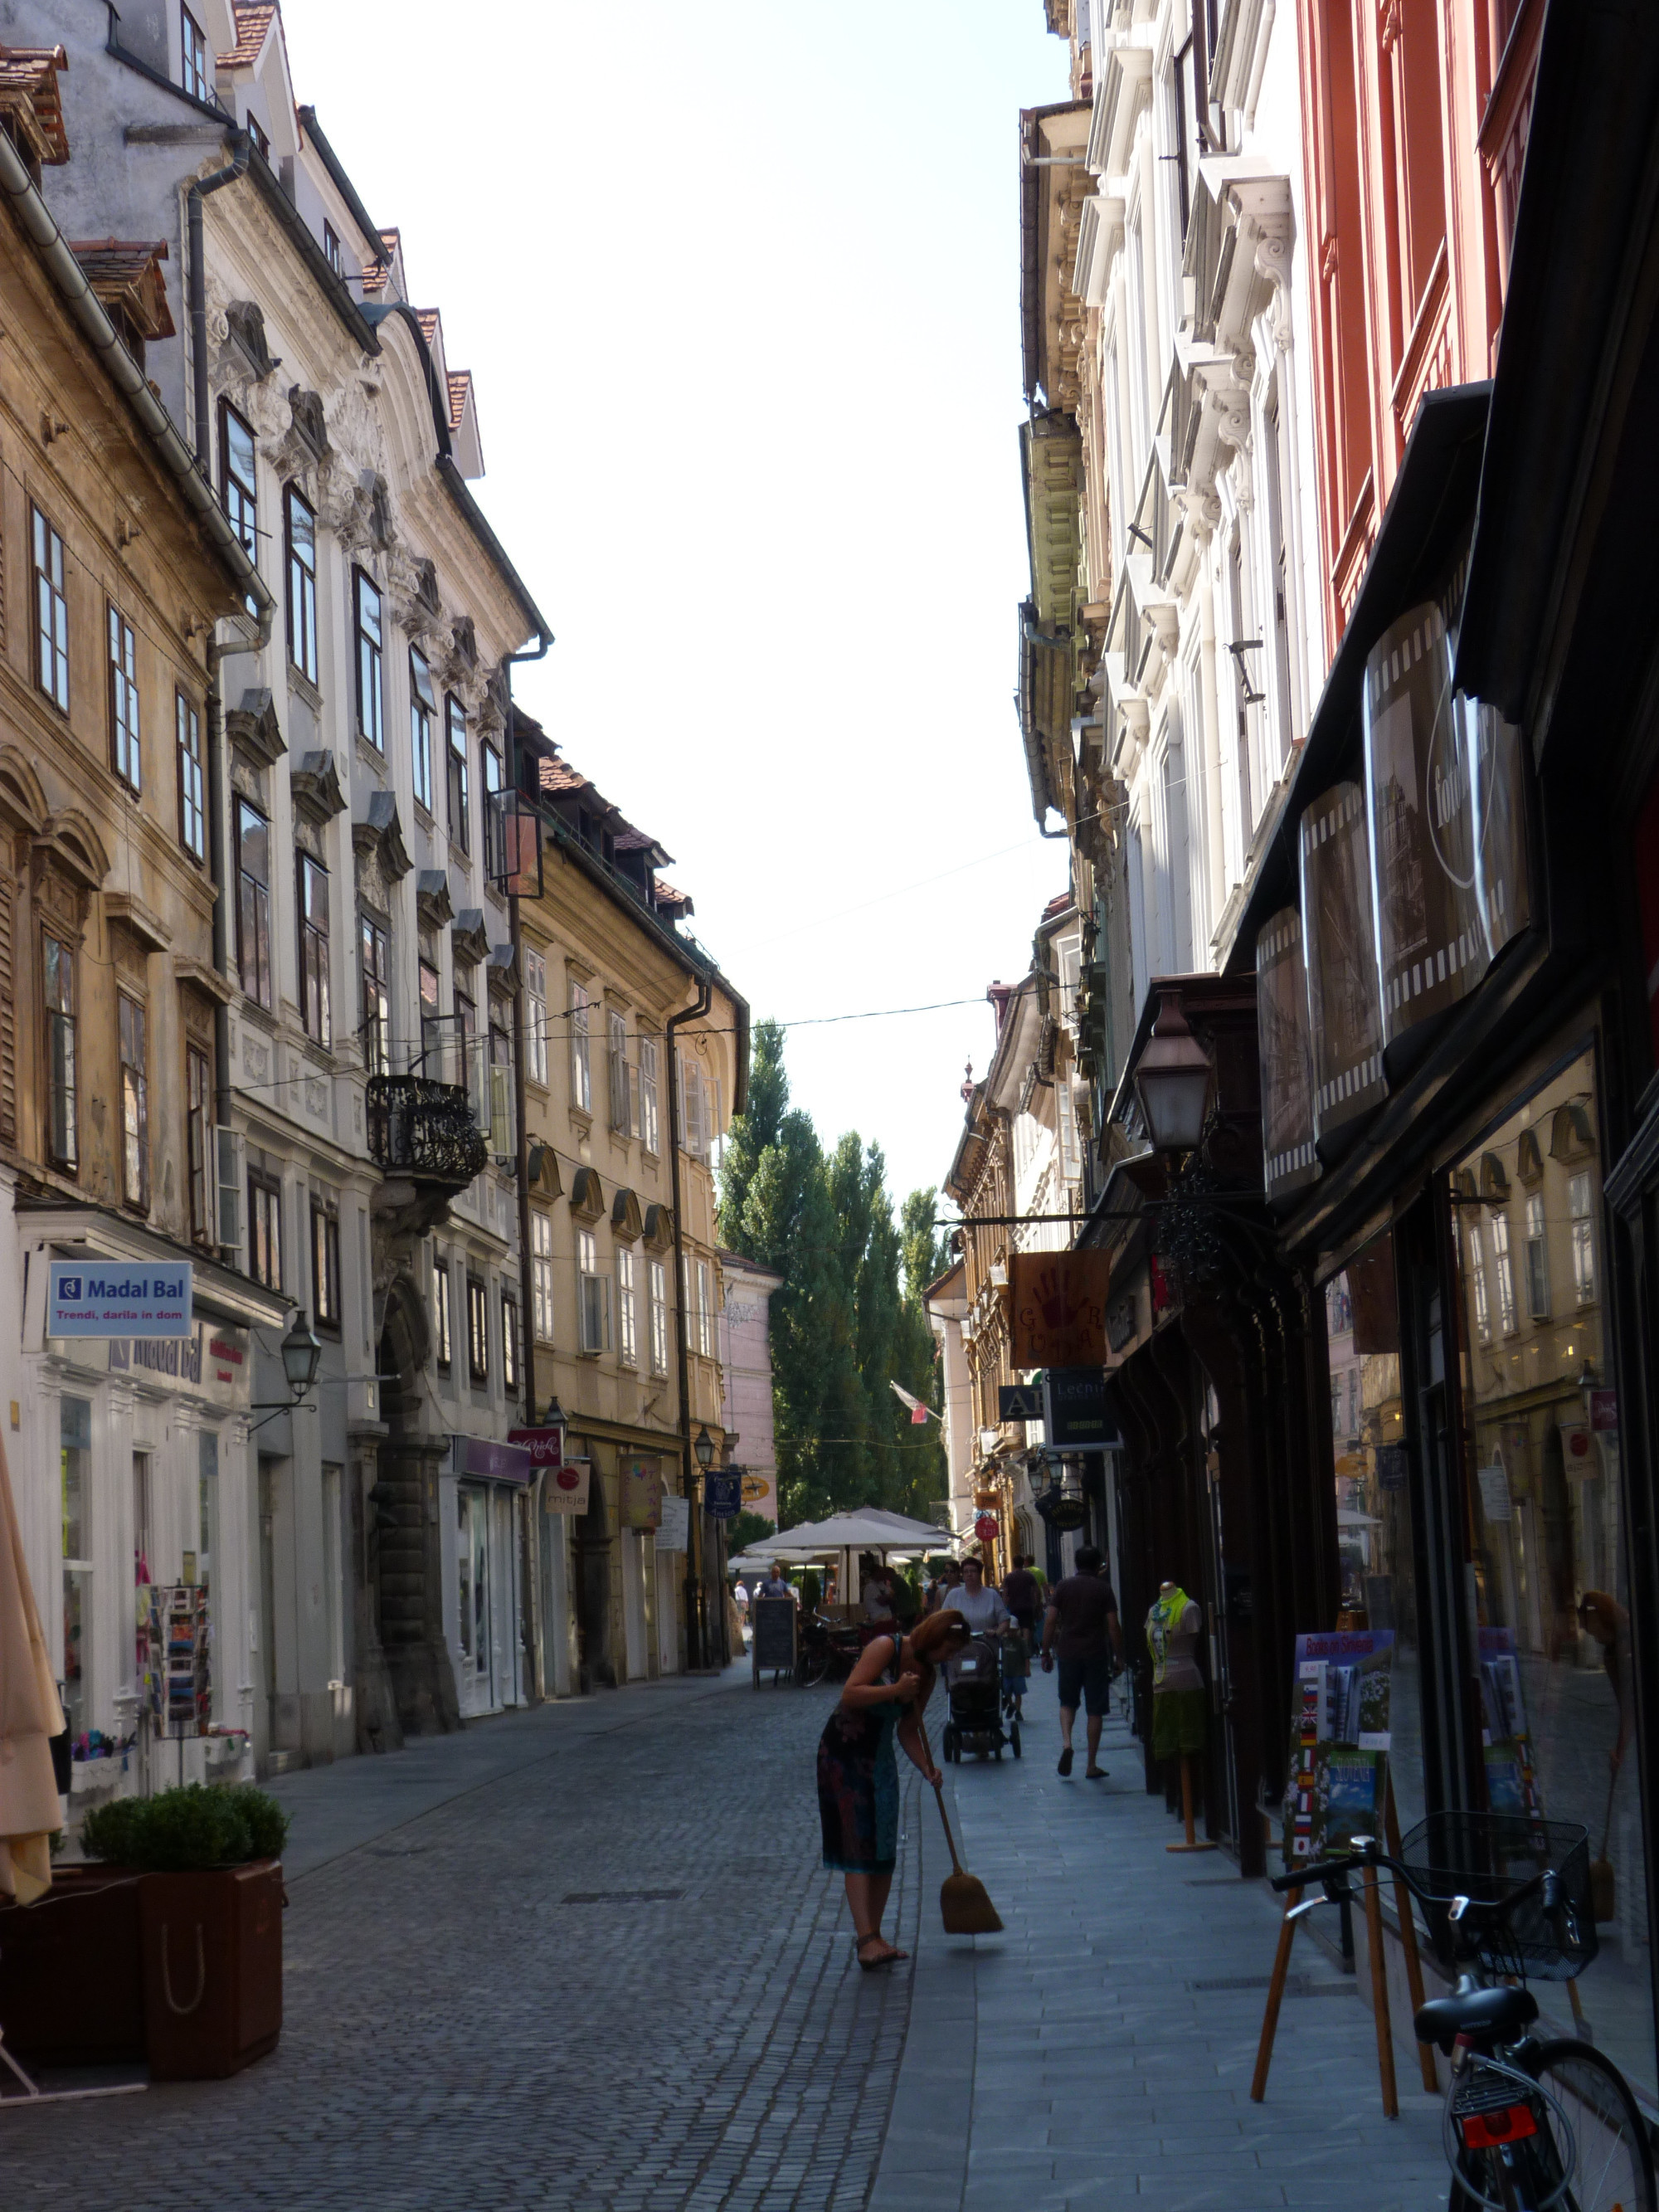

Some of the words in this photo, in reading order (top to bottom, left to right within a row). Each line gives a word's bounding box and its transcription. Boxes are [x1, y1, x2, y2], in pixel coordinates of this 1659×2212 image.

[88, 1279, 148, 1298] Madal
[153, 1279, 184, 1298] Bal
[56, 1309, 100, 1321] Trendi,
[103, 1309, 138, 1320] darila
[141, 1309, 153, 1320] in
[157, 1309, 182, 1320] dom
[547, 1493, 586, 1507] mitja
